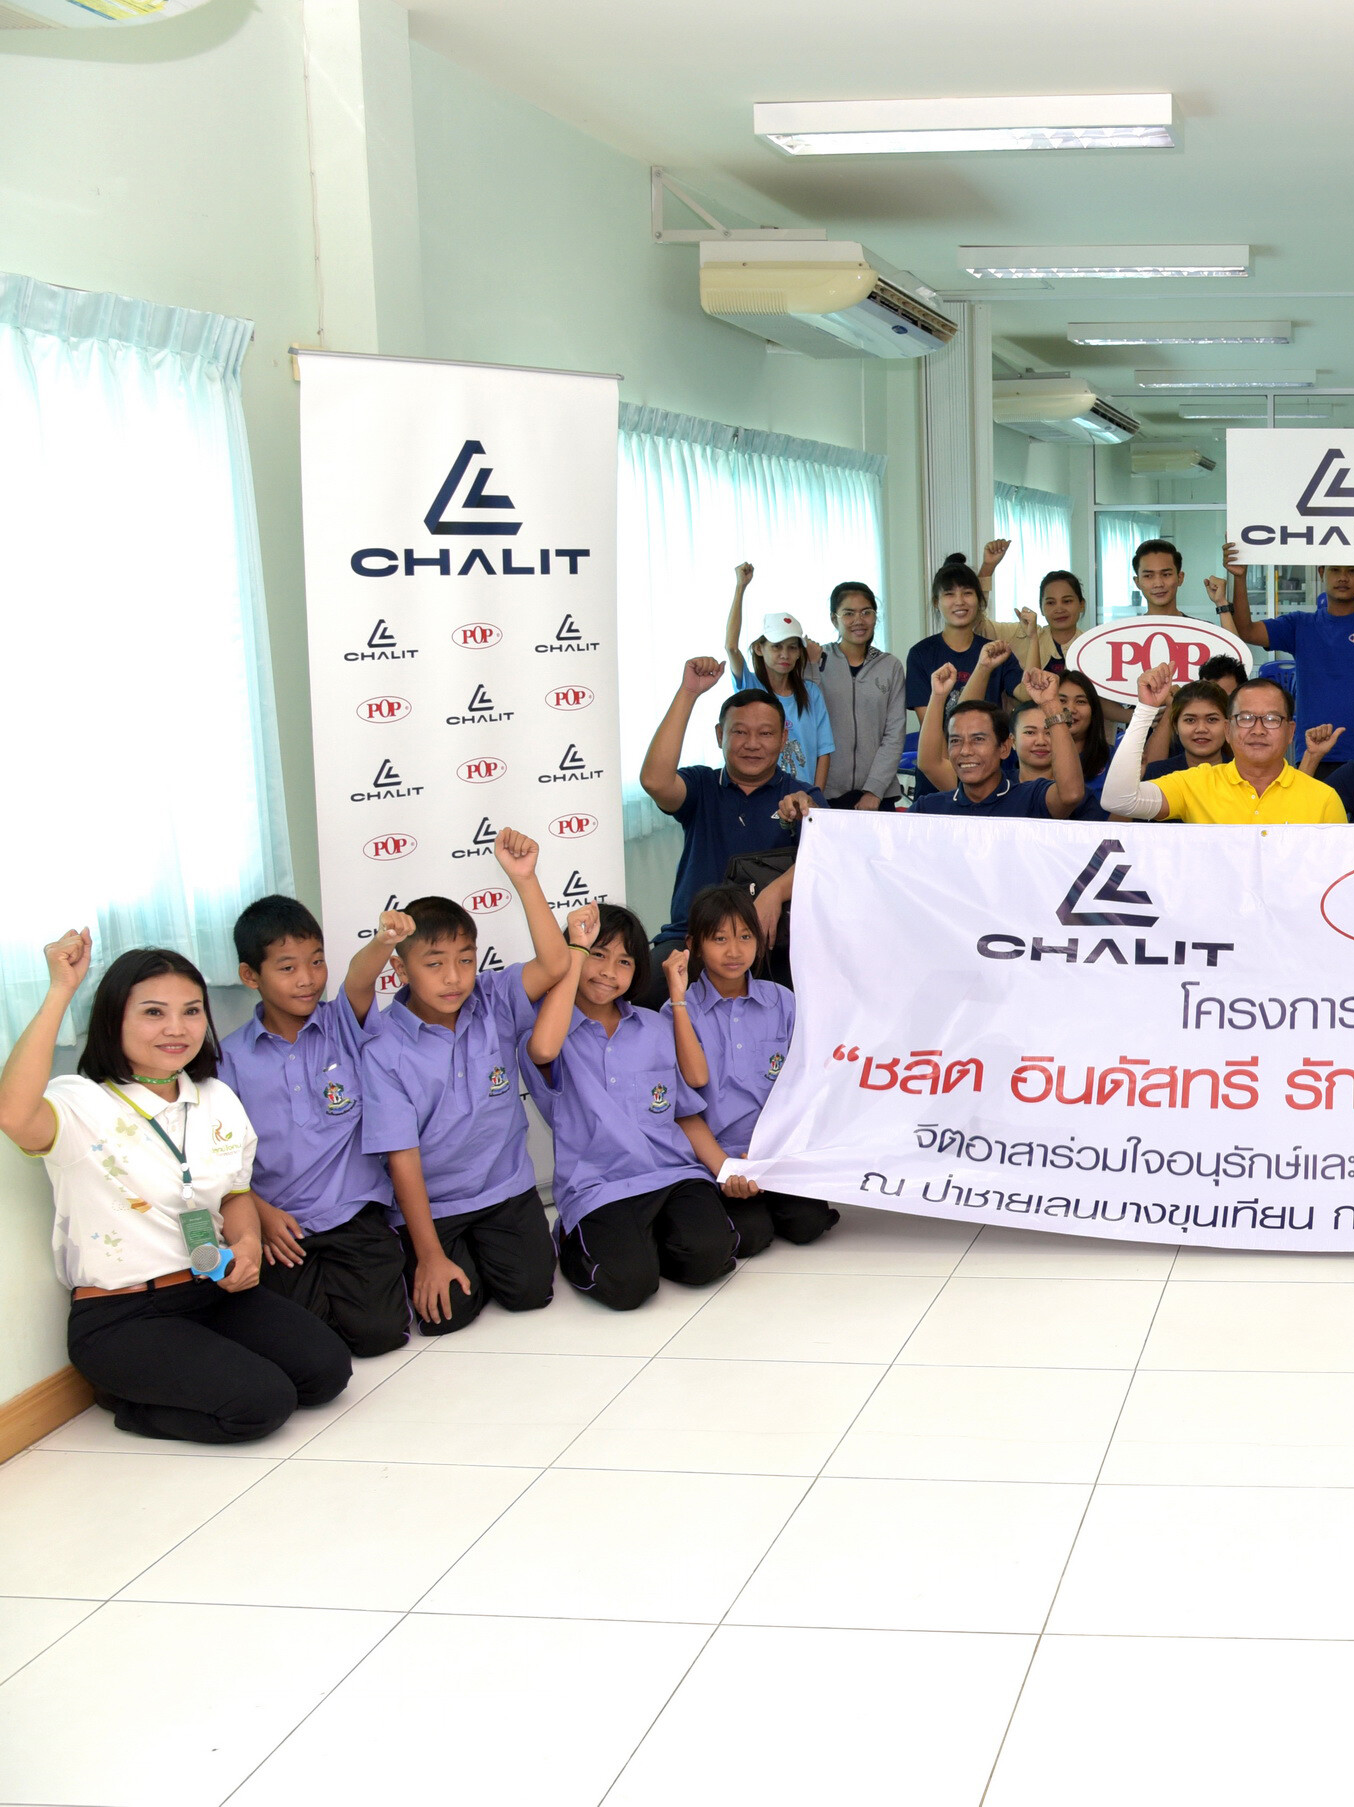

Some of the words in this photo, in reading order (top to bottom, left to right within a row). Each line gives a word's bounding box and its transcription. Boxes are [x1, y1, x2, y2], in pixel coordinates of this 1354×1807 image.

[350, 548, 591, 578] CHALIT
[462, 626, 493, 644] POP
[343, 649, 419, 662] CHALIT
[535, 642, 600, 653] CHALIT
[1106, 631, 1211, 683] POP
[554, 688, 586, 707] POP
[366, 699, 402, 719] POP
[446, 712, 515, 726] CHALIT
[466, 760, 498, 780] POP
[538, 770, 604, 784] CHALIT
[350, 786, 425, 803] CHALIT
[558, 815, 590, 835] POP
[372, 835, 408, 857] POP
[451, 847, 493, 859] CHA
[471, 890, 503, 911] POP
[977, 934, 1234, 967] CHALIT
[380, 971, 405, 991] PO
[1010, 1055, 1259, 1110] อินดัสทรี
[859, 1171, 905, 1197] ณ
[921, 1173, 1315, 1234] ป่าชายเลนบางขุนเทียน
